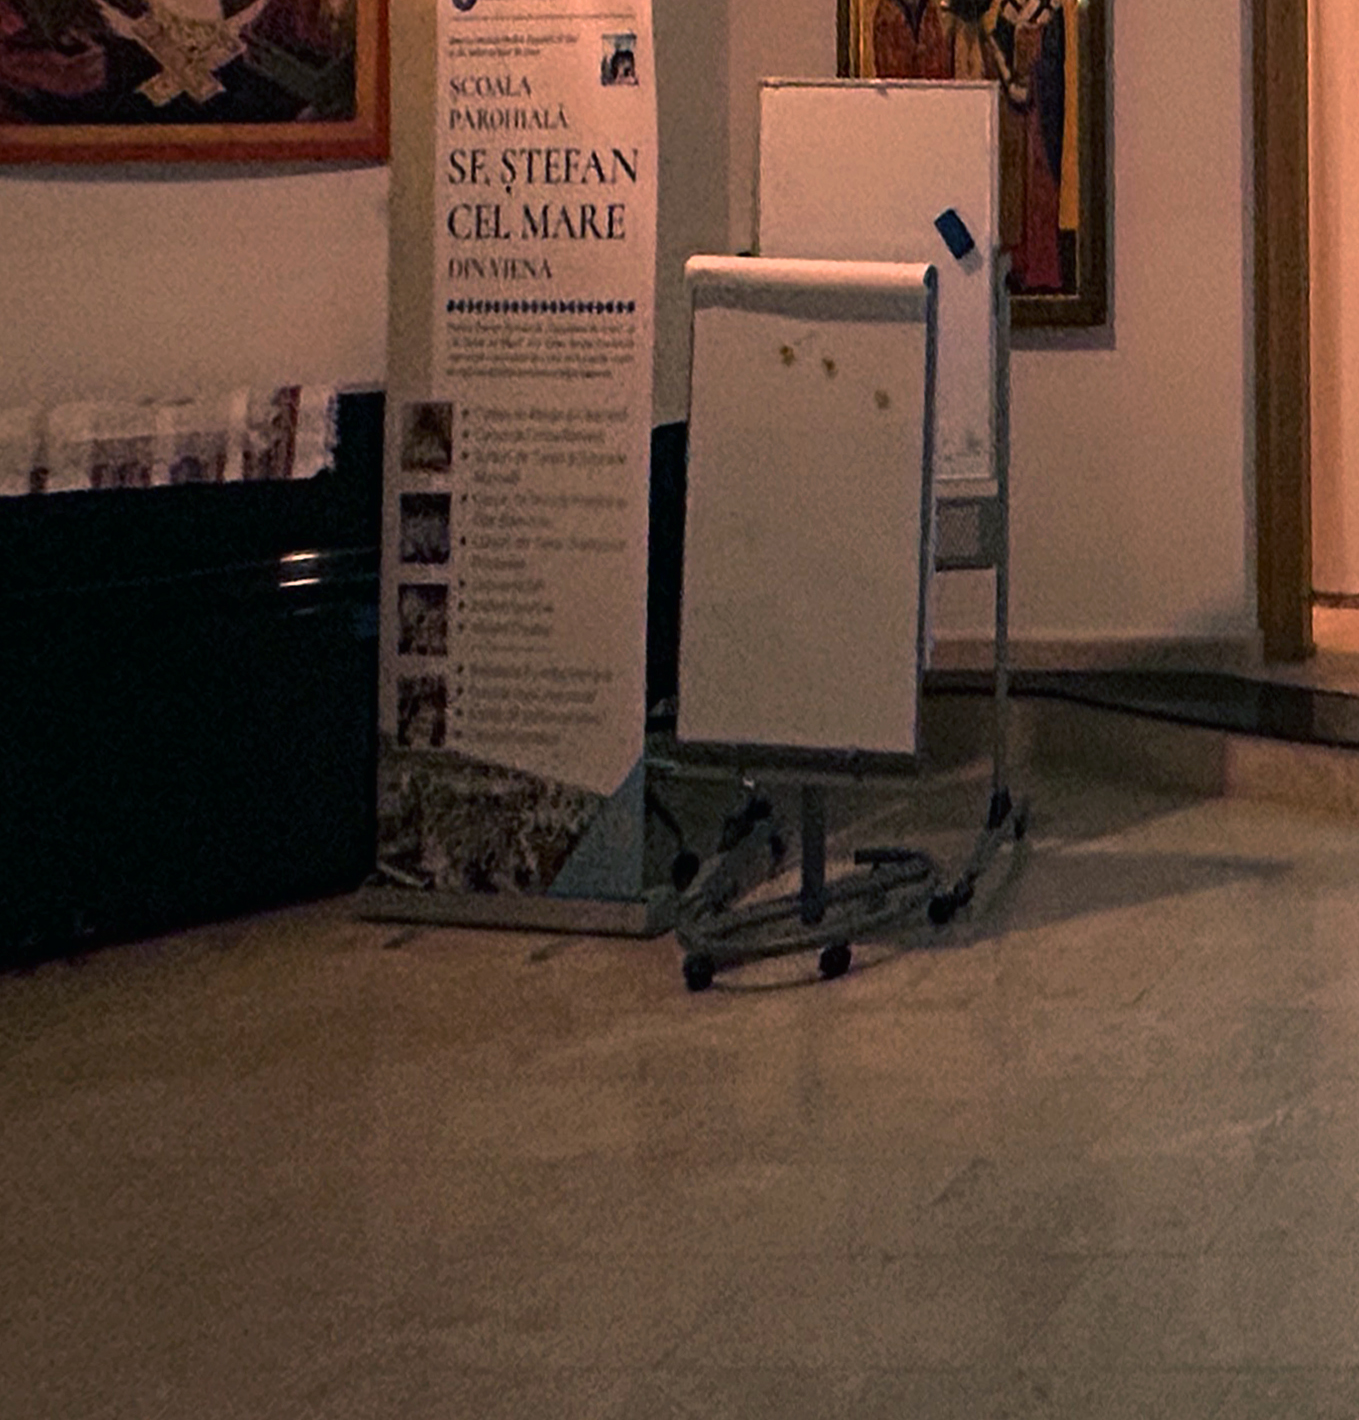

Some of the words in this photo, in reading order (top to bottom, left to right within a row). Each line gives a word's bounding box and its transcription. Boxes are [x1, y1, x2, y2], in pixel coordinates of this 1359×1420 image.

[500, 147, 638, 195] ȘTEFAN
[447, 203, 510, 240] CEL
[521, 203, 626, 240] MARE
[448, 258, 485, 279] DIN
[489, 257, 553, 280] VIENA
